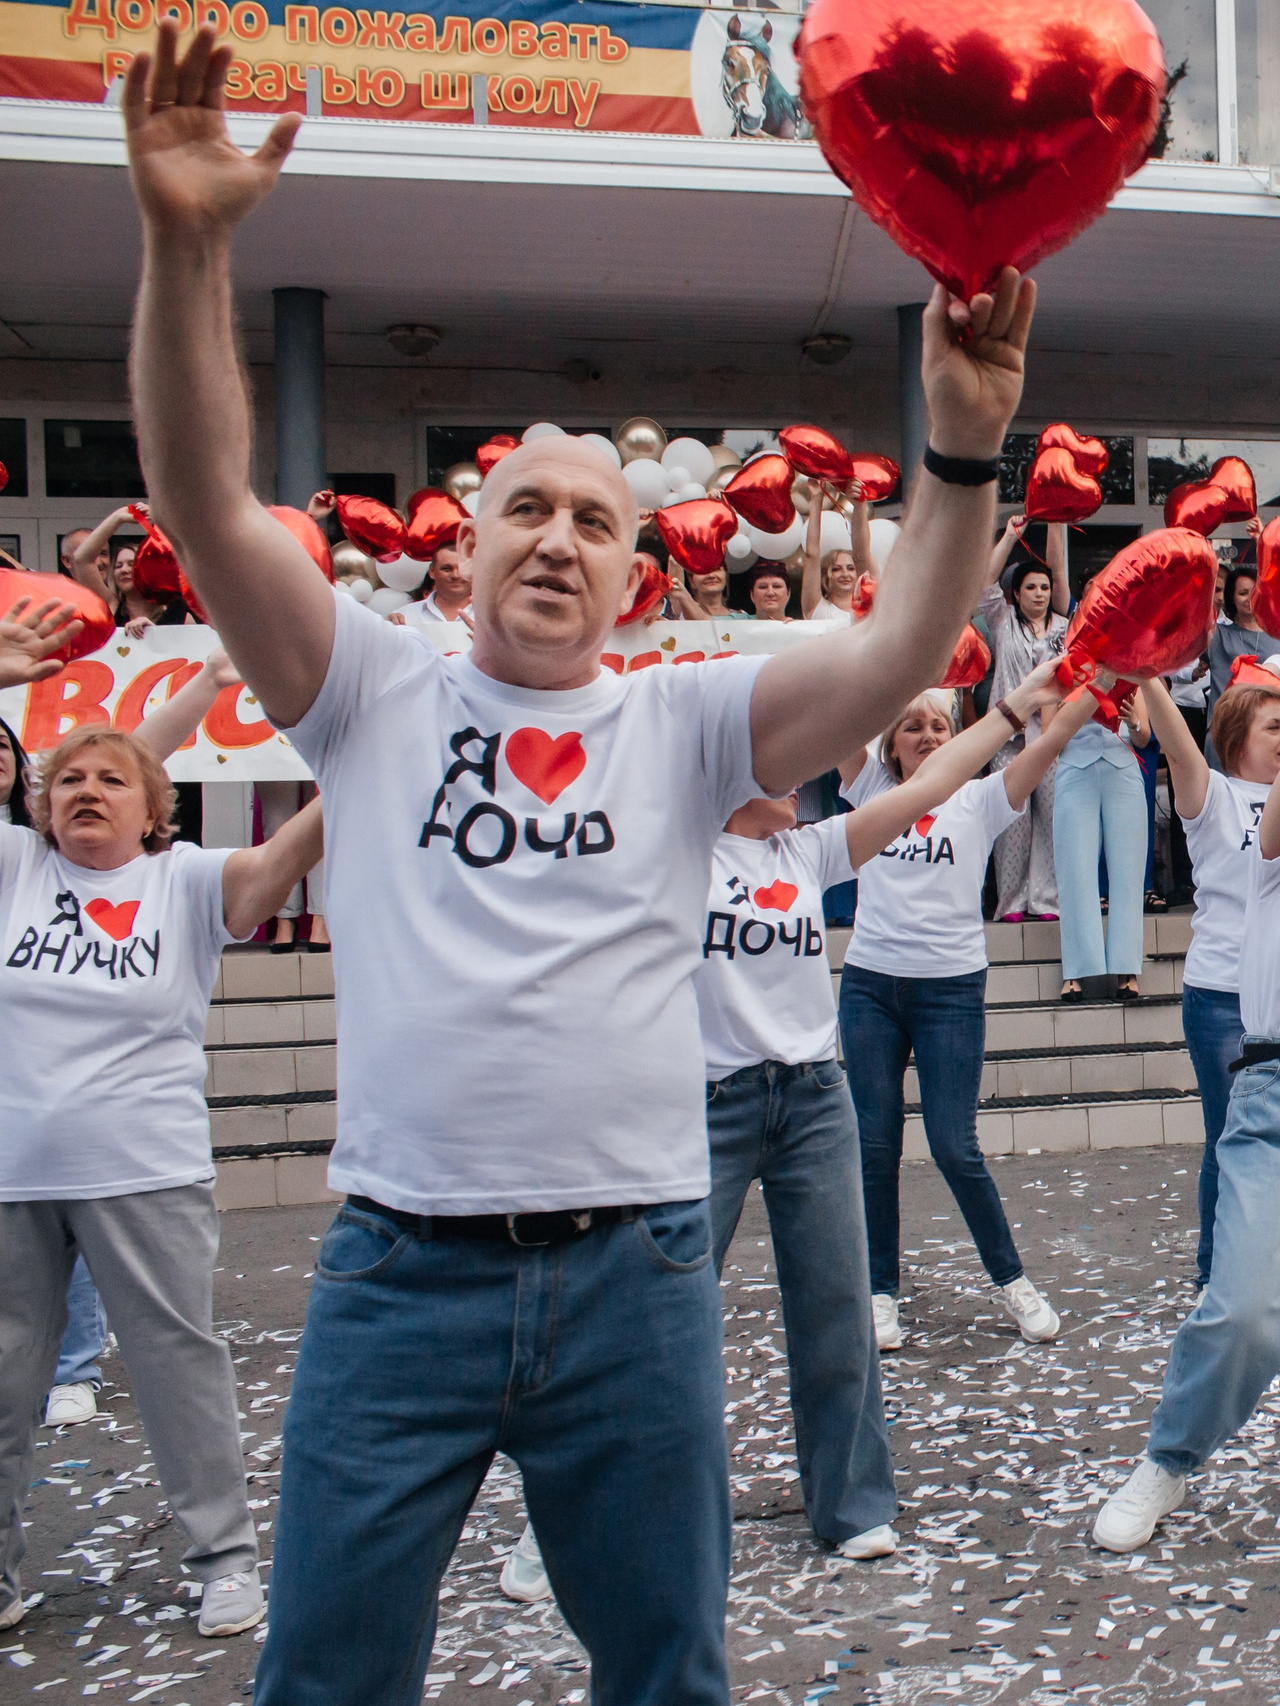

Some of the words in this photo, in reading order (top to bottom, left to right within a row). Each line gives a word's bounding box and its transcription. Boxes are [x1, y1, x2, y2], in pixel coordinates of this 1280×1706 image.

[64, 0, 270, 40] Добро
[285, 4, 630, 63] пожаловать
[444, 726, 502, 797] Я
[47, 889, 84, 937] Я
[702, 910, 823, 961] ДОЧЬ
[5, 925, 161, 981] ВНУЧКУ
